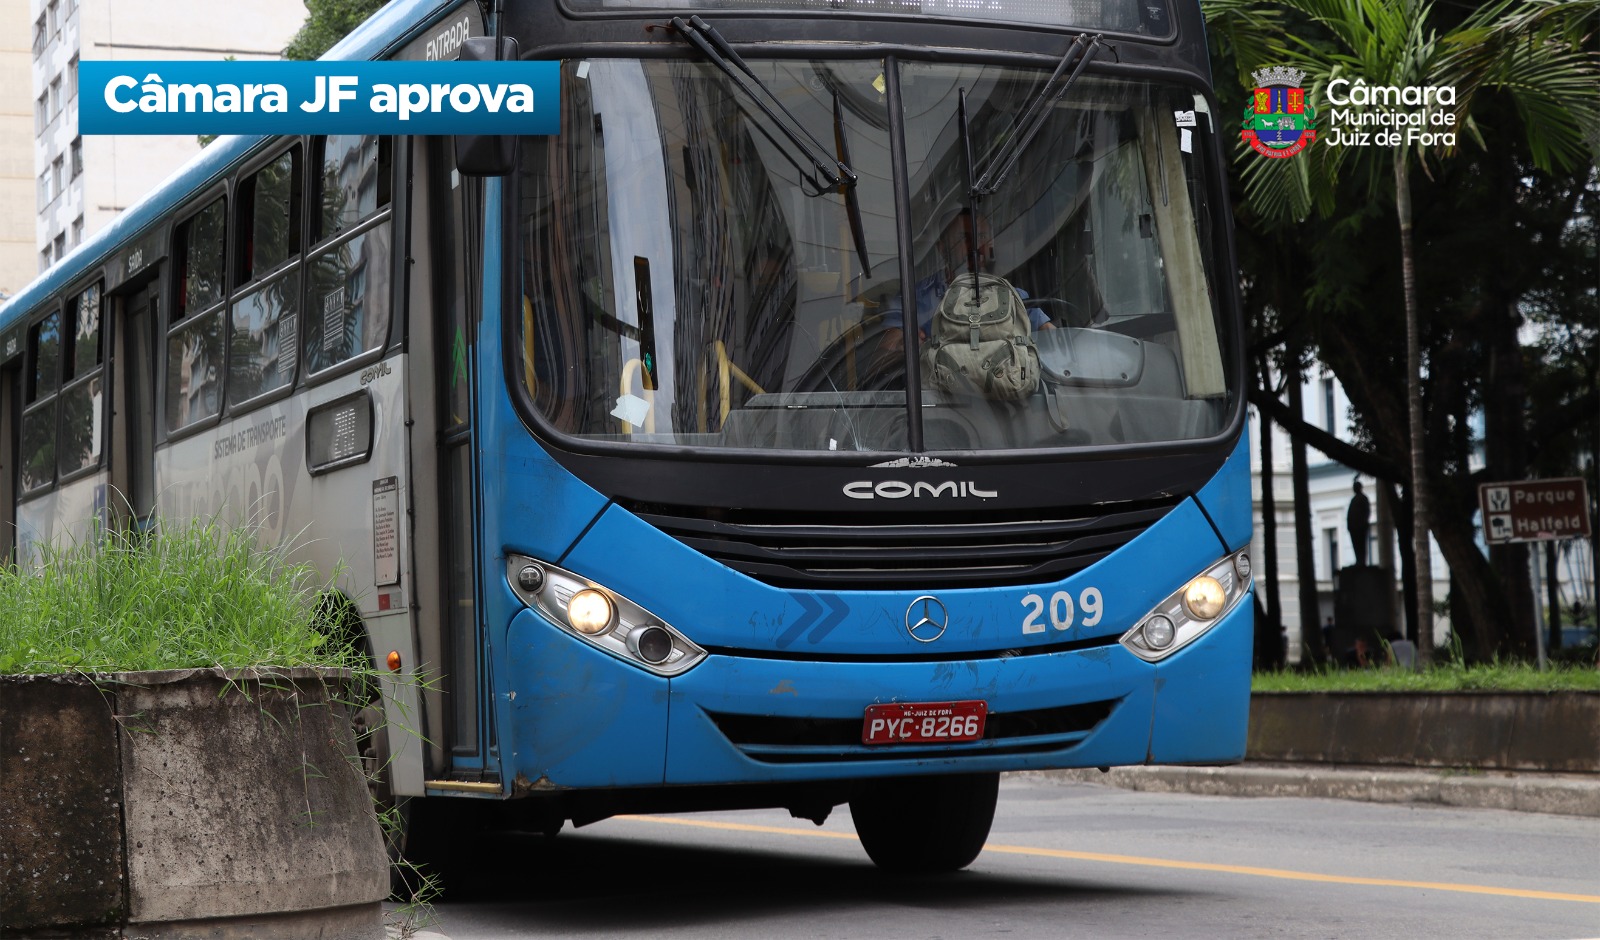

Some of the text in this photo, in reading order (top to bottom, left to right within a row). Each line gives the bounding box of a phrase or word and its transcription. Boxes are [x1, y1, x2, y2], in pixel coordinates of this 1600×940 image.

[360, 362, 391, 385] COMIL
[215, 415, 286, 459] SISTEMA DE TRANSPORTE
[843, 481, 998, 499] COMIL
[1514, 490, 1575, 504] Parque
[1517, 515, 1580, 532] Halfeld
[1021, 587, 1103, 634] 209
